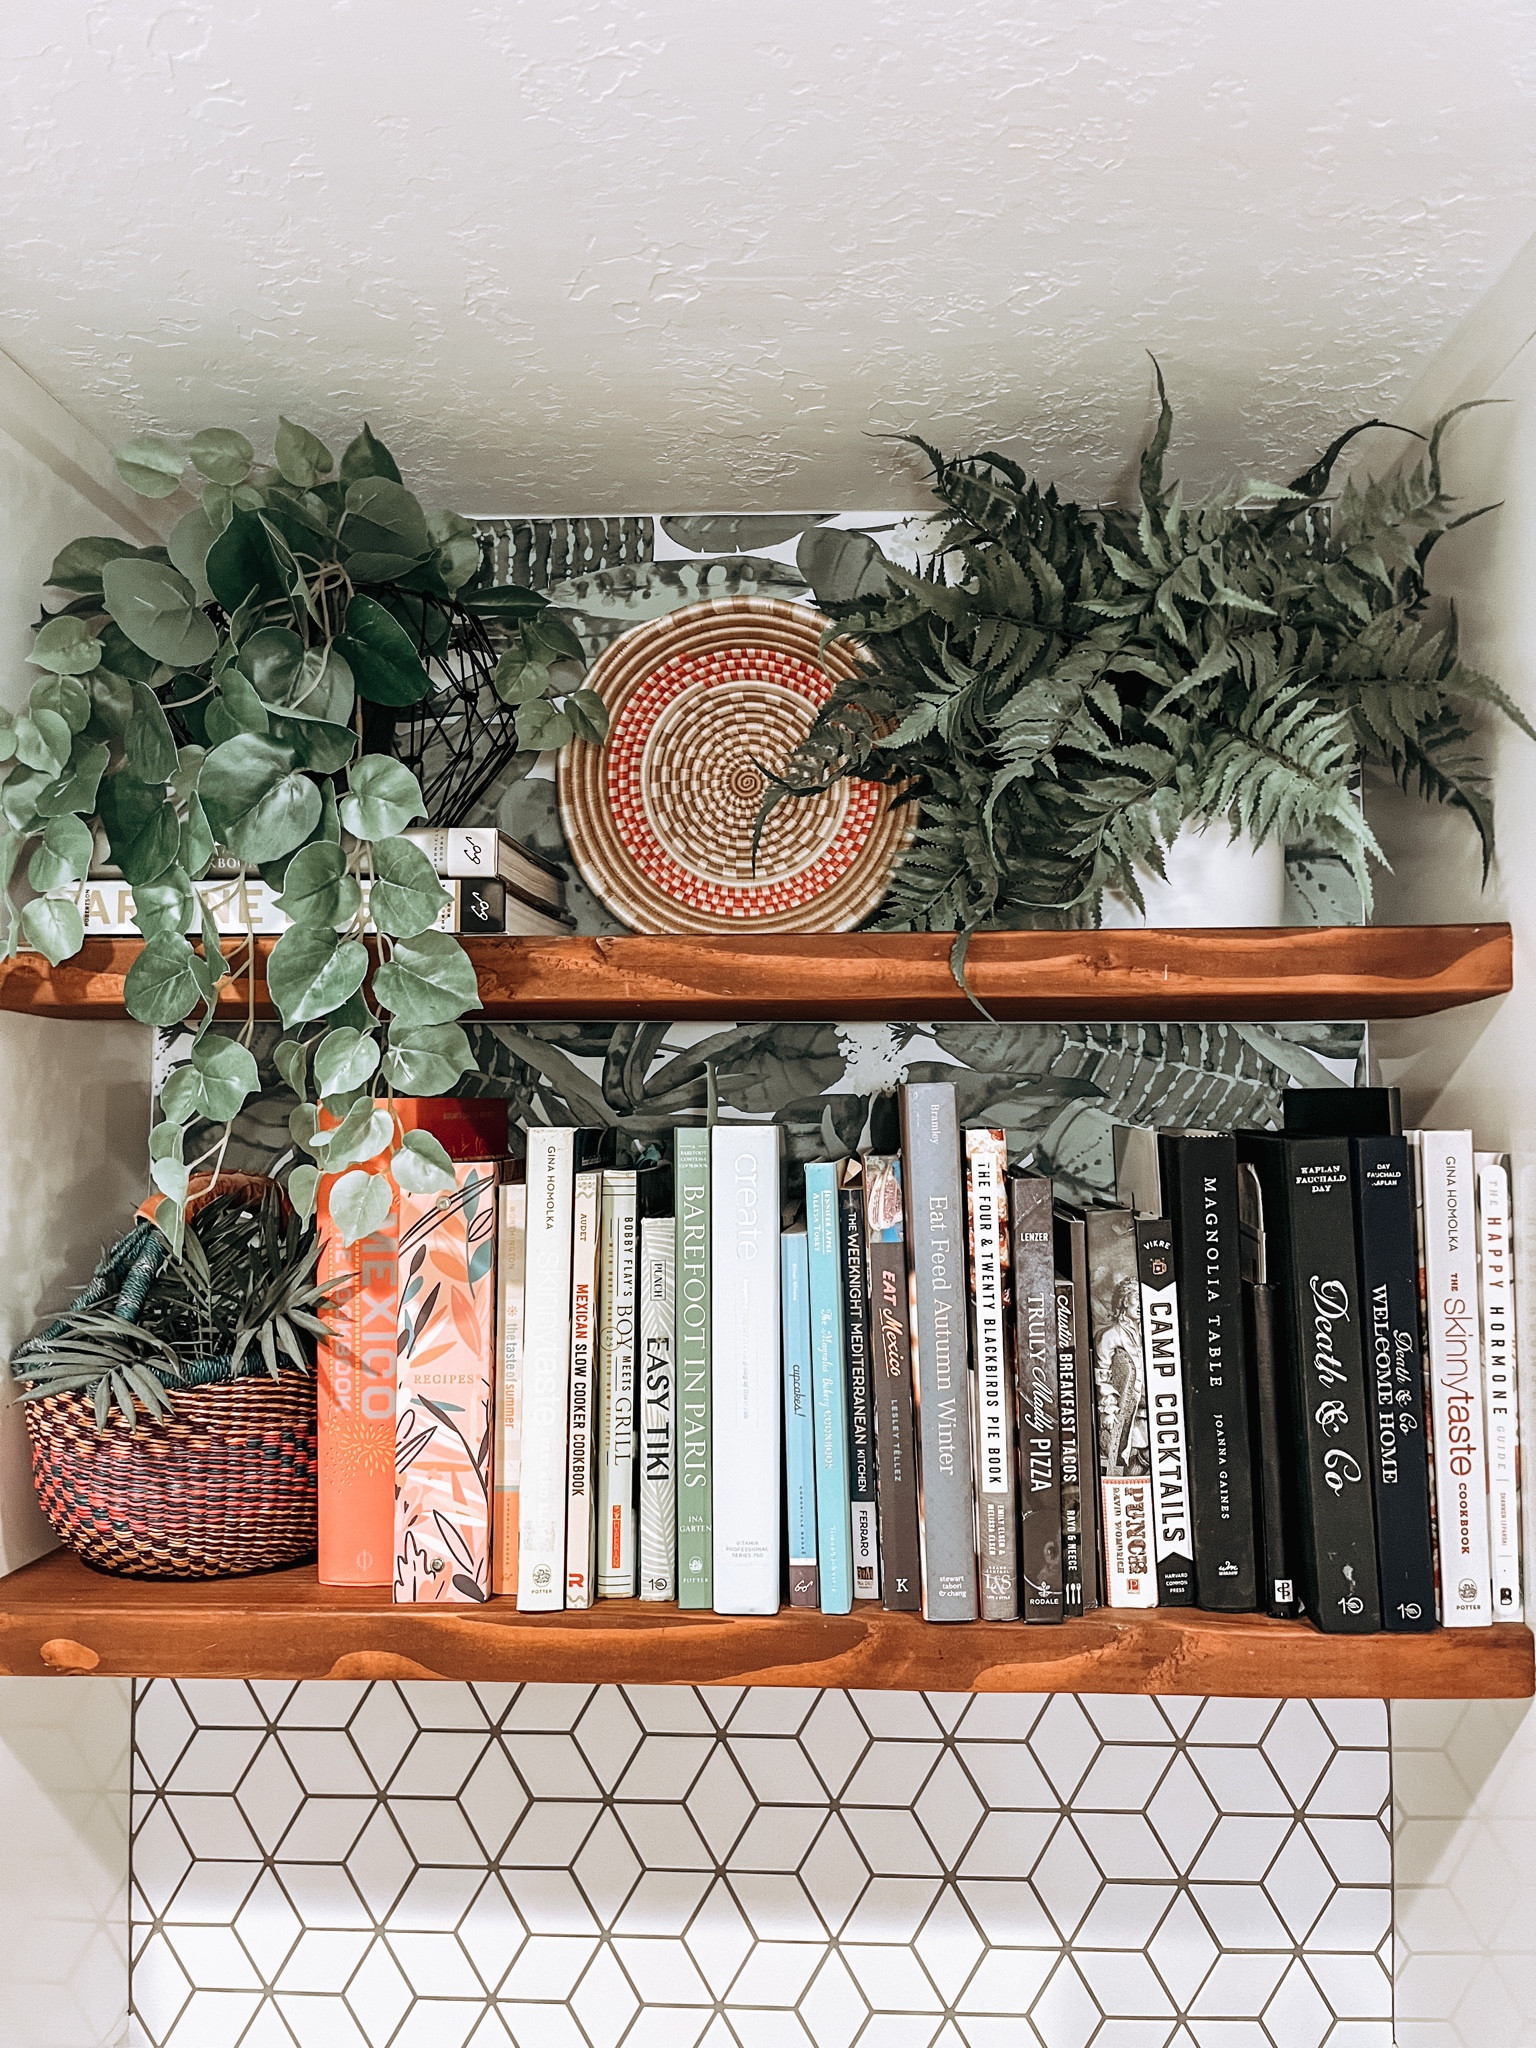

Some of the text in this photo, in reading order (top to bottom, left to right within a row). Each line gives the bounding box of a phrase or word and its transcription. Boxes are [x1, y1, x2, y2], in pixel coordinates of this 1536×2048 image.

[929, 1103, 941, 1145] Bramley
[546, 1145, 557, 1231] GINA HOMOLKA
[734, 1153, 762, 1261] create
[1295, 1174, 1347, 1184] FAUCHALD
[1300, 1165, 1341, 1174] KAPLAN
[1311, 1184, 1332, 1193] DAY
[1446, 1156, 1459, 1252] GINA HOMOLKA
[508, 1206, 517, 1270] WORTHINGTON
[812, 1193, 822, 1252] ALLYSA TOREY
[823, 1190, 833, 1255] JENNIFER APPEL
[1020, 1232, 1049, 1242] LENZER
[1143, 1237, 1171, 1250] VIKRE
[653, 1263, 662, 1298] PUNCH
[683, 1184, 706, 1350] BAREFOOT
[1203, 1177, 1223, 1388] MAGNOLIA TABLE
[362, 1213, 397, 1420] MEXICO
[613, 1217, 634, 1467] BOBBY FLAY'S BOY MEETS GRILL
[847, 1212, 868, 1492] THE WEEKNIGHT MEDITERRANEAN KITCHEN
[882, 1269, 904, 1378] EAT Mexico
[929, 1195, 957, 1476] Eat Feed Autumn Winter
[978, 1162, 1001, 1484] THE FOUR & TWENTY BLACKBIRDS PIE BOOK
[1487, 1180, 1508, 1470] THE HAPPY HORMONE GUIDE
[413, 1373, 475, 1385] RECIPES
[504, 1323, 519, 1429] the taste of summer
[572, 1284, 589, 1496] MEXICAN SLOW COOKER COOKBOOK
[646, 1337, 669, 1481] EASY TIKI
[683, 1357, 706, 1394] IN
[789, 1364, 806, 1418] cupcakes!
[817, 1308, 834, 1469] The Magnolia Bakery COOKBOOK
[1024, 1293, 1054, 1493] TRULY Madly PIZZA
[1057, 1294, 1078, 1483] Austin BREAKFAST TACOS
[1308, 1275, 1362, 1496] Death & Co
[1371, 1283, 1398, 1485] WELCOME HOME
[1392, 1329, 1418, 1436] Death & Co
[1441, 1272, 1477, 1555] THE skinnytaste COOKBOOK
[683, 1401, 706, 1488] PARIS
[891, 1399, 903, 1482] LESLEY TÉLLEZ
[1149, 1302, 1186, 1542] CAMP COCKTAILS
[1213, 1413, 1231, 1520] JOANNA GAINES
[679, 1525, 712, 1533] GARTEN
[688, 1515, 703, 1523] INA
[859, 1510, 869, 1557] FERRARO
[987, 1503, 997, 1556] MELISSA ELSEN
[997, 1504, 1005, 1525] EMILY
[998, 1527, 1006, 1548] ELSEN
[1067, 1509, 1076, 1532] RAYO
[1068, 1543, 1077, 1571] NEECE
[1112, 1487, 1125, 1575] DAVID WONDRICH
[1125, 1486, 1148, 1575] PUNCH
[895, 1578, 909, 1592] K
[947, 1590, 966, 1598] chang
